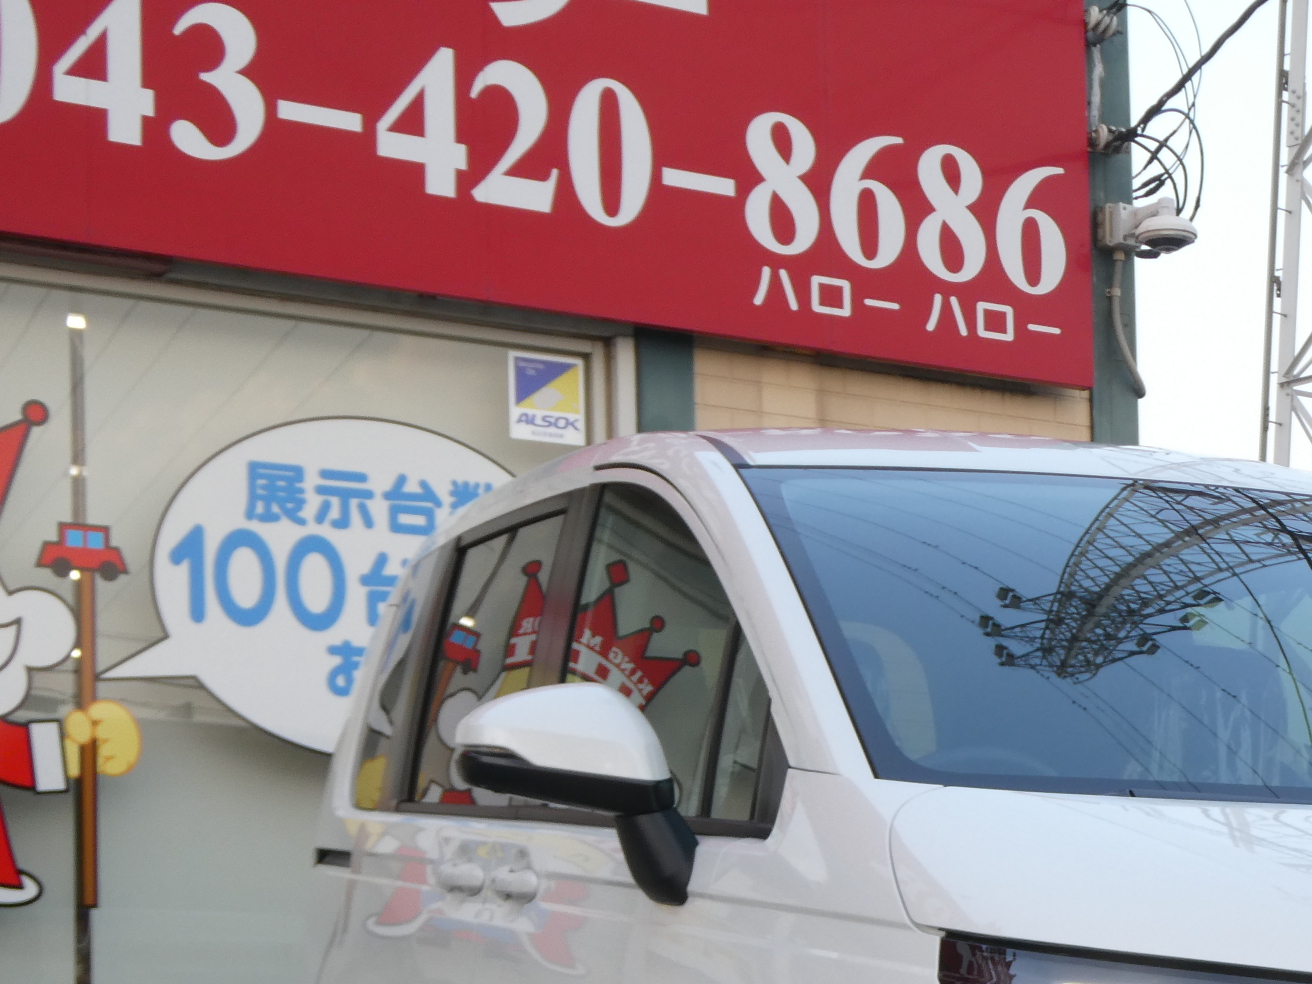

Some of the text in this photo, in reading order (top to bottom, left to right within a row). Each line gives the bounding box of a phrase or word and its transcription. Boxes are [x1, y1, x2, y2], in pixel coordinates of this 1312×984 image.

[753, 265, 1062, 342] ハロー ハロー
[515, 411, 581, 432] ALSOK
